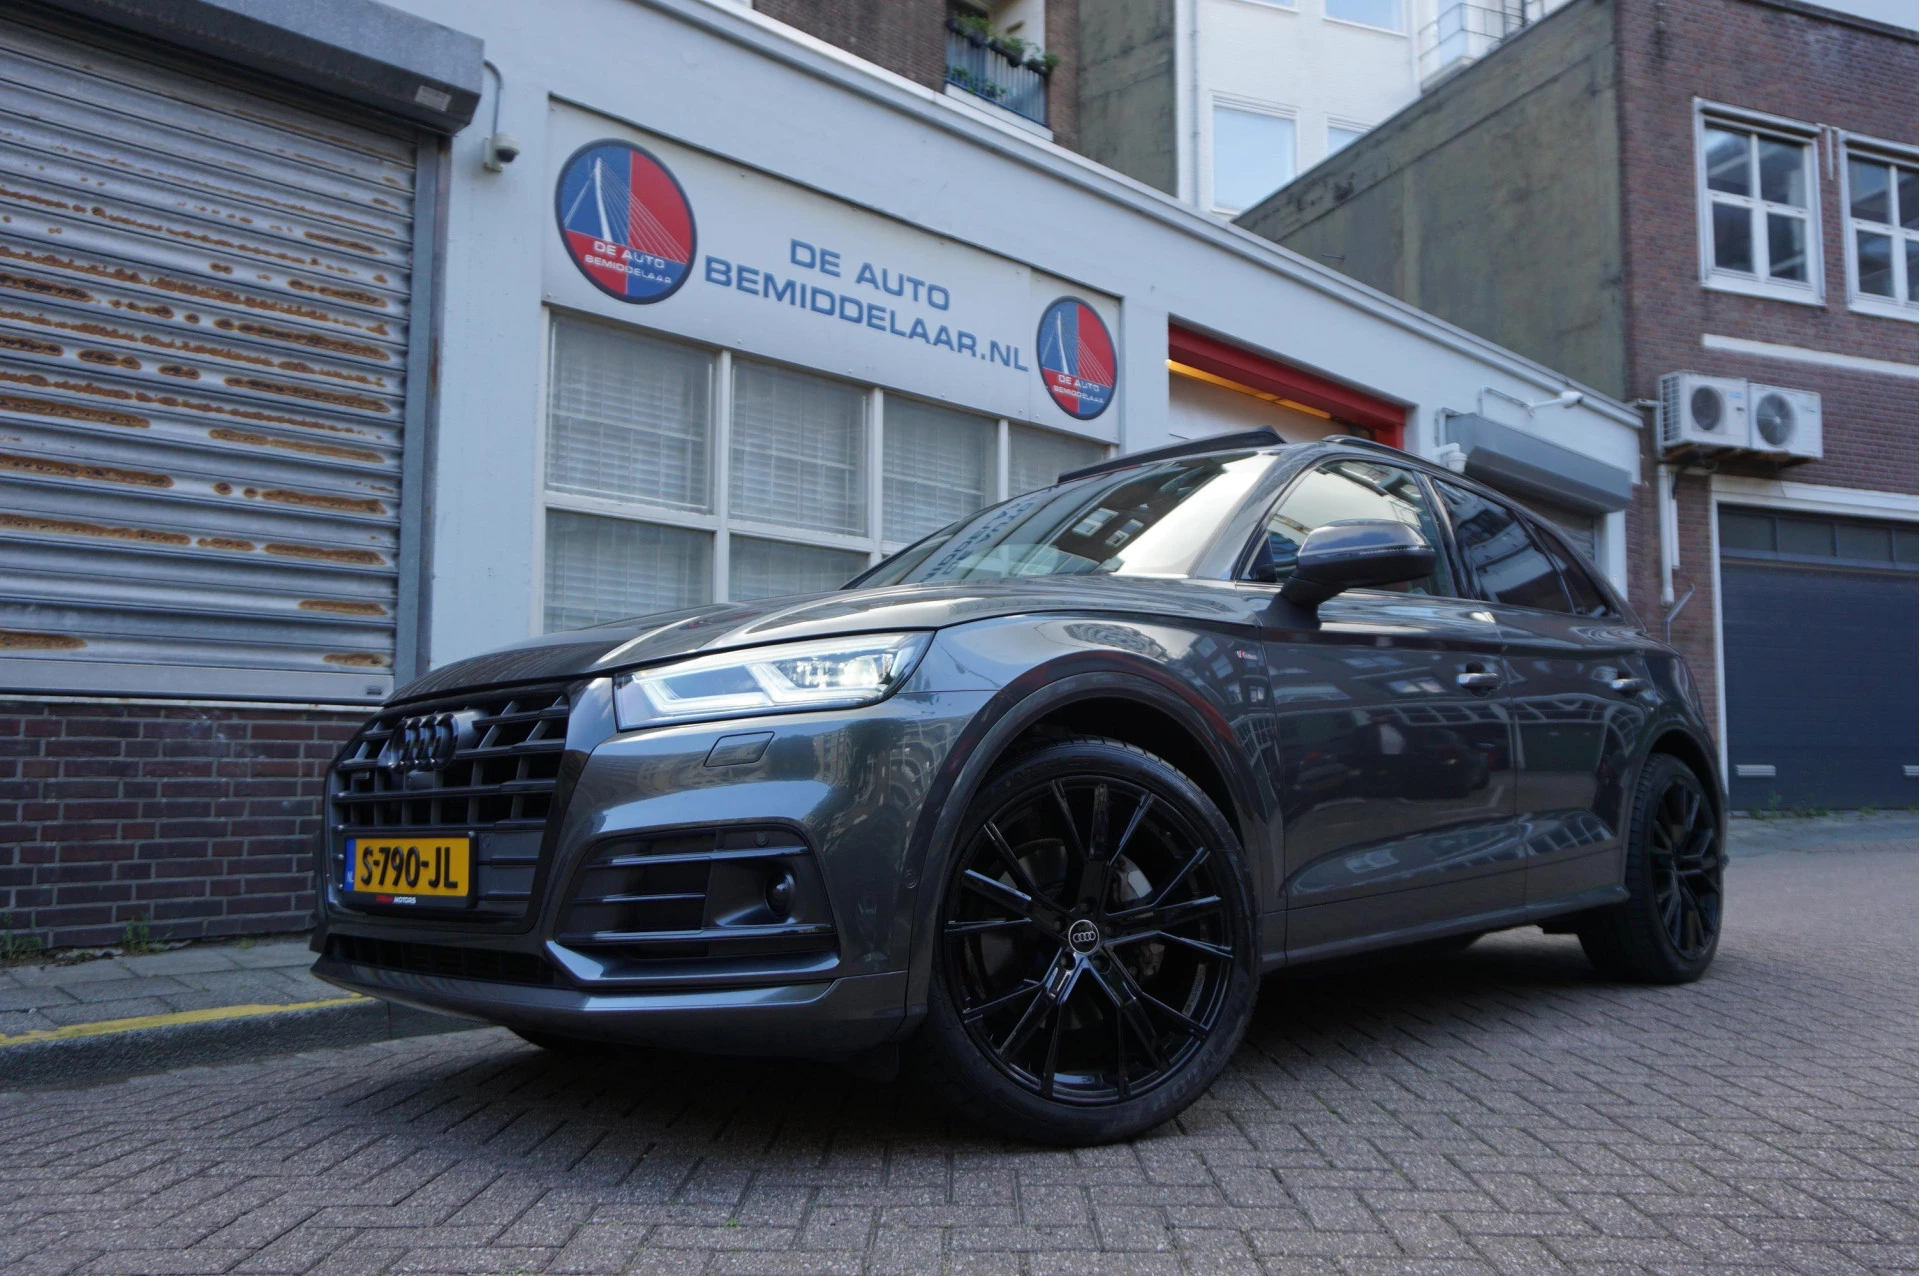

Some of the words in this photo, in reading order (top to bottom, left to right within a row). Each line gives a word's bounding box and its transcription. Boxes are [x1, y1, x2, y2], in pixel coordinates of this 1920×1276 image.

[584, 254, 672, 284] BEMIDDELAAR
[593, 240, 617, 256] DE
[621, 250, 665, 269] AUTO
[790, 238, 841, 278] DE
[855, 262, 950, 311] AUTO
[704, 254, 1029, 372] BEMIDDELAAR.NL
[1053, 385, 1104, 404] BEMIDDELAAR
[1058, 374, 1072, 385] DE
[1074, 379, 1100, 392] AUTO
[346, 871, 354, 883] NL
[361, 846, 458, 889] S-790-JL
[393, 896, 417, 904] MOTORS
